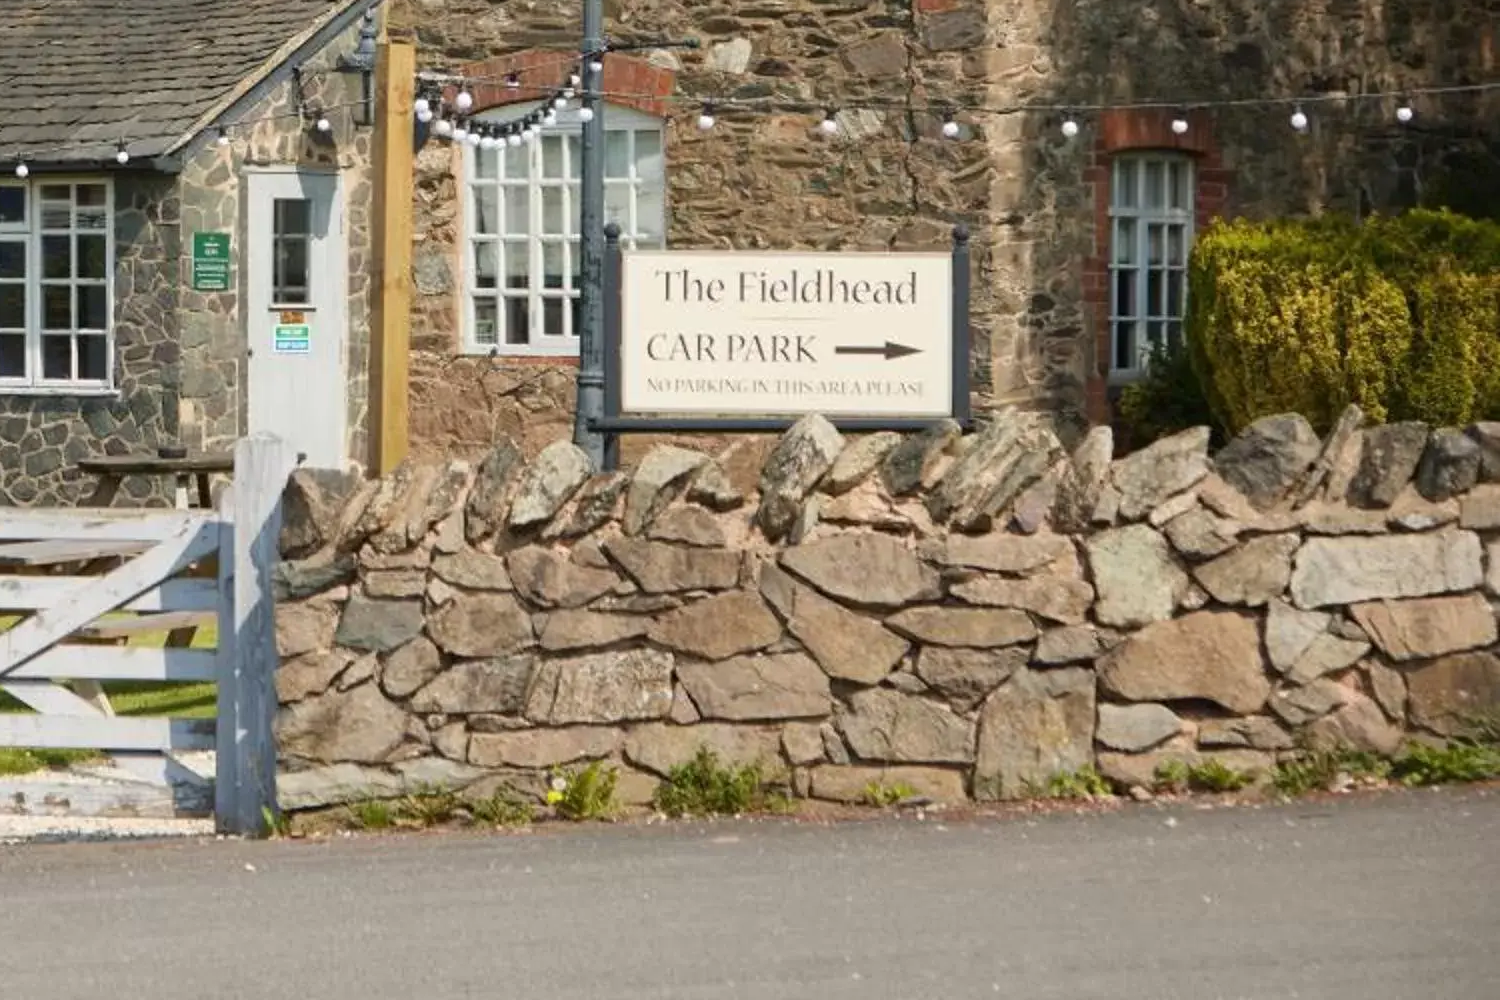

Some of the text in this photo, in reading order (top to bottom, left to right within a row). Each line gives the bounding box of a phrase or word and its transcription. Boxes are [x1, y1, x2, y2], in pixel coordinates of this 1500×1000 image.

[655, 269, 917, 304] The Fieldhead
[647, 333, 817, 363] CAR PARK
[647, 378, 924, 397] NO PARKING IN THIS AREA PLEASE
